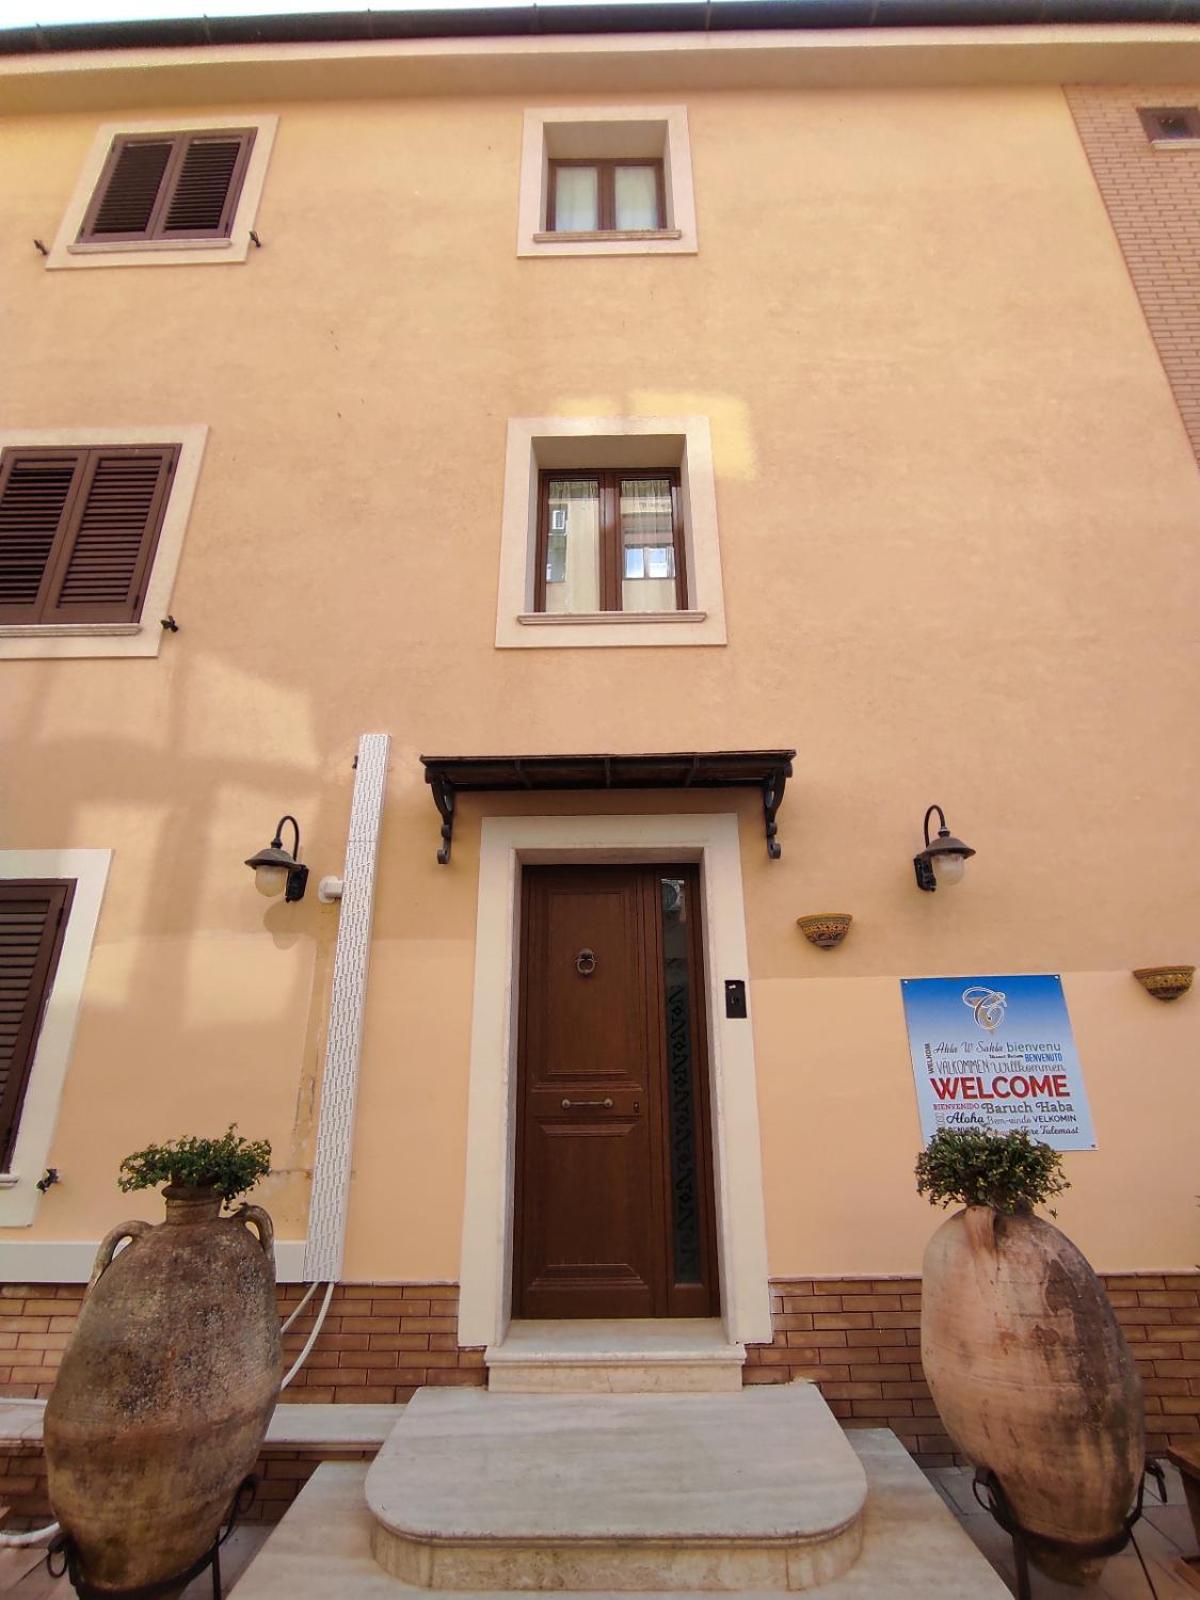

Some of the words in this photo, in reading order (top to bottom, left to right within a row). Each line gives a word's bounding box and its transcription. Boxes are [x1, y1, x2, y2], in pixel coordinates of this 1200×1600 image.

[1006, 1042, 1061, 1052] bienvenu
[1024, 1053, 1063, 1062] BENVENUTO
[929, 1075, 1070, 1100] WELCOME
[981, 1101, 1033, 1114] Baruch
[1035, 1101, 1074, 1113] Haba
[946, 1112, 984, 1124] Aloha
[1032, 1115, 1077, 1123] VELKOMIN
